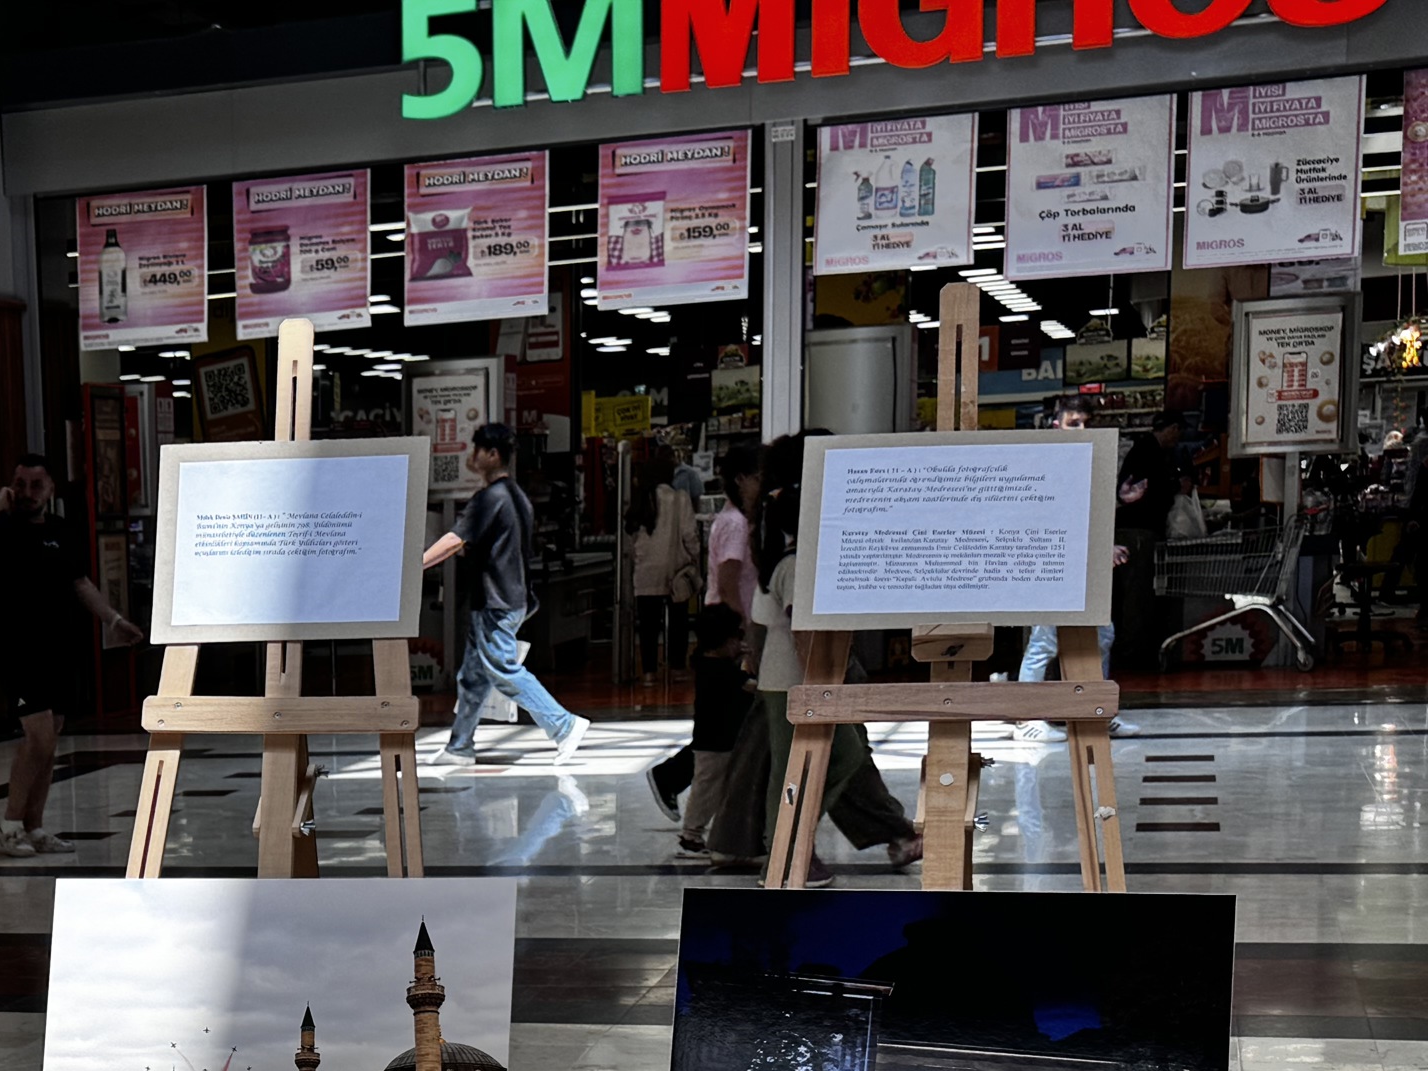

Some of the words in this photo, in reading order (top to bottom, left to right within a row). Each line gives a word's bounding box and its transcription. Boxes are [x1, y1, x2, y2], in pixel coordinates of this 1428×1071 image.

[1254, 101, 1271, 113] İYİ
[1273, 98, 1317, 112] FİYATA
[1065, 114, 1078, 124] İYİ
[1080, 111, 1118, 123] FİYATA
[620, 150, 664, 167] HODRİ
[1296, 156, 1340, 167] Züccaciye
[1296, 167, 1327, 175] Mutfak
[424, 170, 467, 188] HODRİ
[1295, 173, 1348, 184] Ürünlerinde
[254, 187, 293, 204] HODRİ
[1307, 187, 1319, 195] AL
[1308, 193, 1343, 204] HEDİYE
[95, 202, 133, 218] HODRİ
[1039, 209, 1060, 221] Çöp
[1064, 204, 1136, 218] Torbalarında
[1071, 222, 1084, 232] AL
[880, 234, 891, 242] AL
[1072, 230, 1112, 242] HEDİYE
[1211, 636, 1244, 655] 5M
